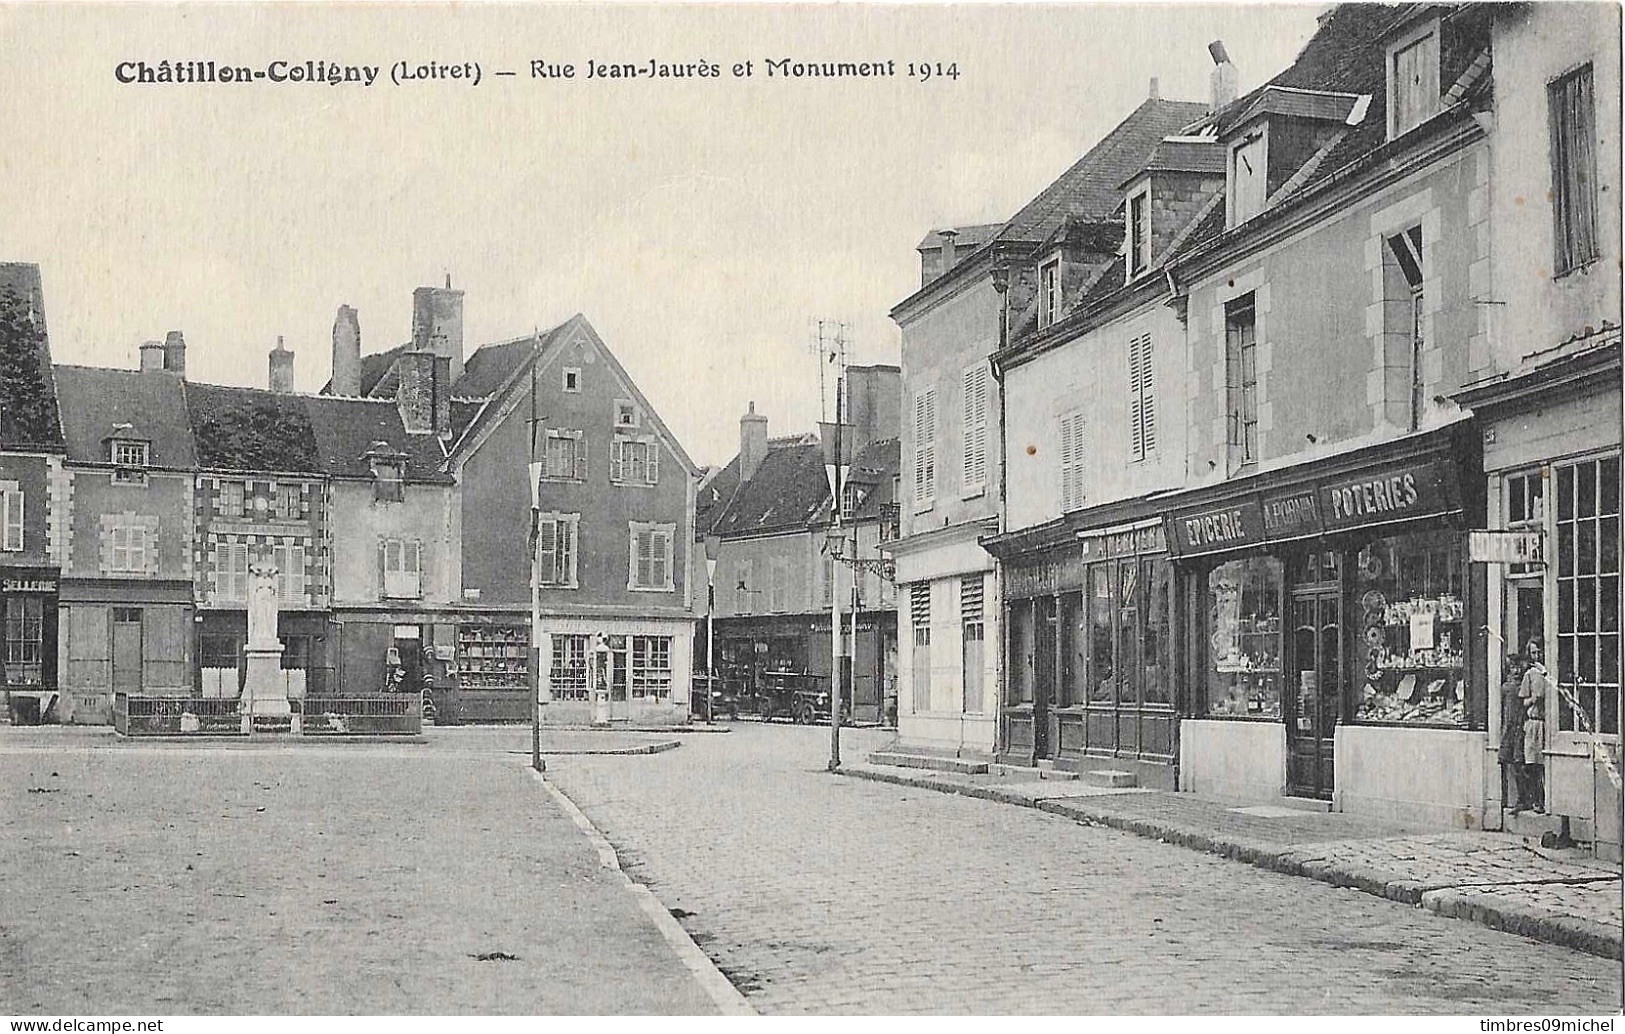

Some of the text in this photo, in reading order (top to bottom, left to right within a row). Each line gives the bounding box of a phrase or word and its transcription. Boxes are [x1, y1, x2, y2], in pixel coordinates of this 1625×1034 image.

[1332, 473, 1418, 519] POTERIES
[1186, 510, 1245, 546] EPICERIE
[2, 578, 57, 592] SELLERIE
